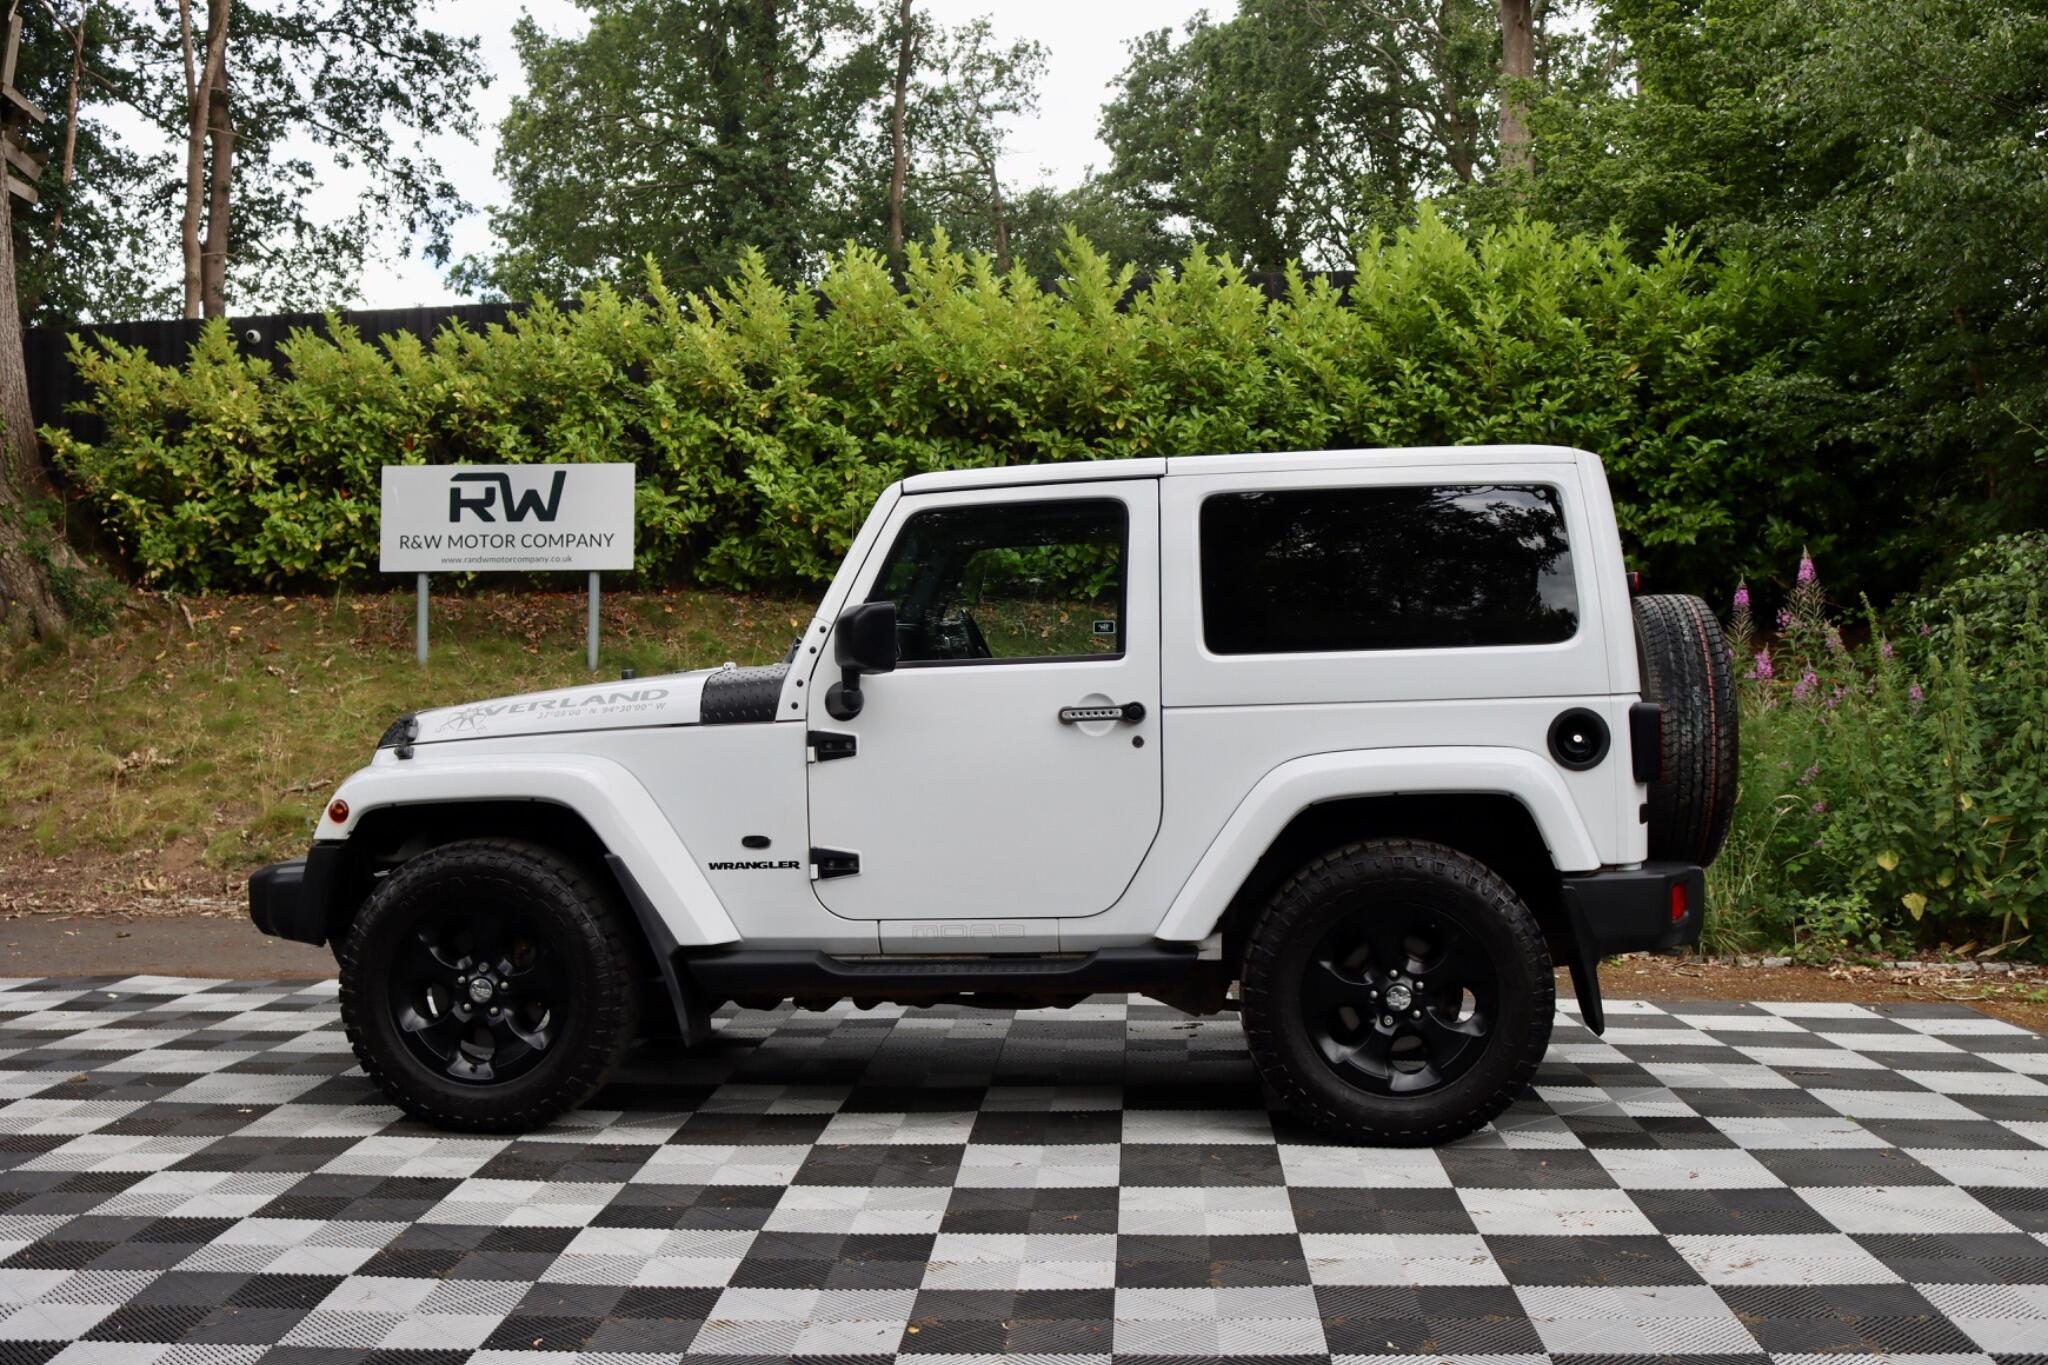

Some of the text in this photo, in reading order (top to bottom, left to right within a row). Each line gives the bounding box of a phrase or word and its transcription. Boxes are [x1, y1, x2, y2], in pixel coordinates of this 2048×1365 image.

[449, 470, 567, 523] RW
[399, 533, 615, 549] R&W MOTOR COMPANY
[440, 555, 573, 565] www.randwmotorcompany.co.uk
[708, 861, 800, 870] WRANGLER
